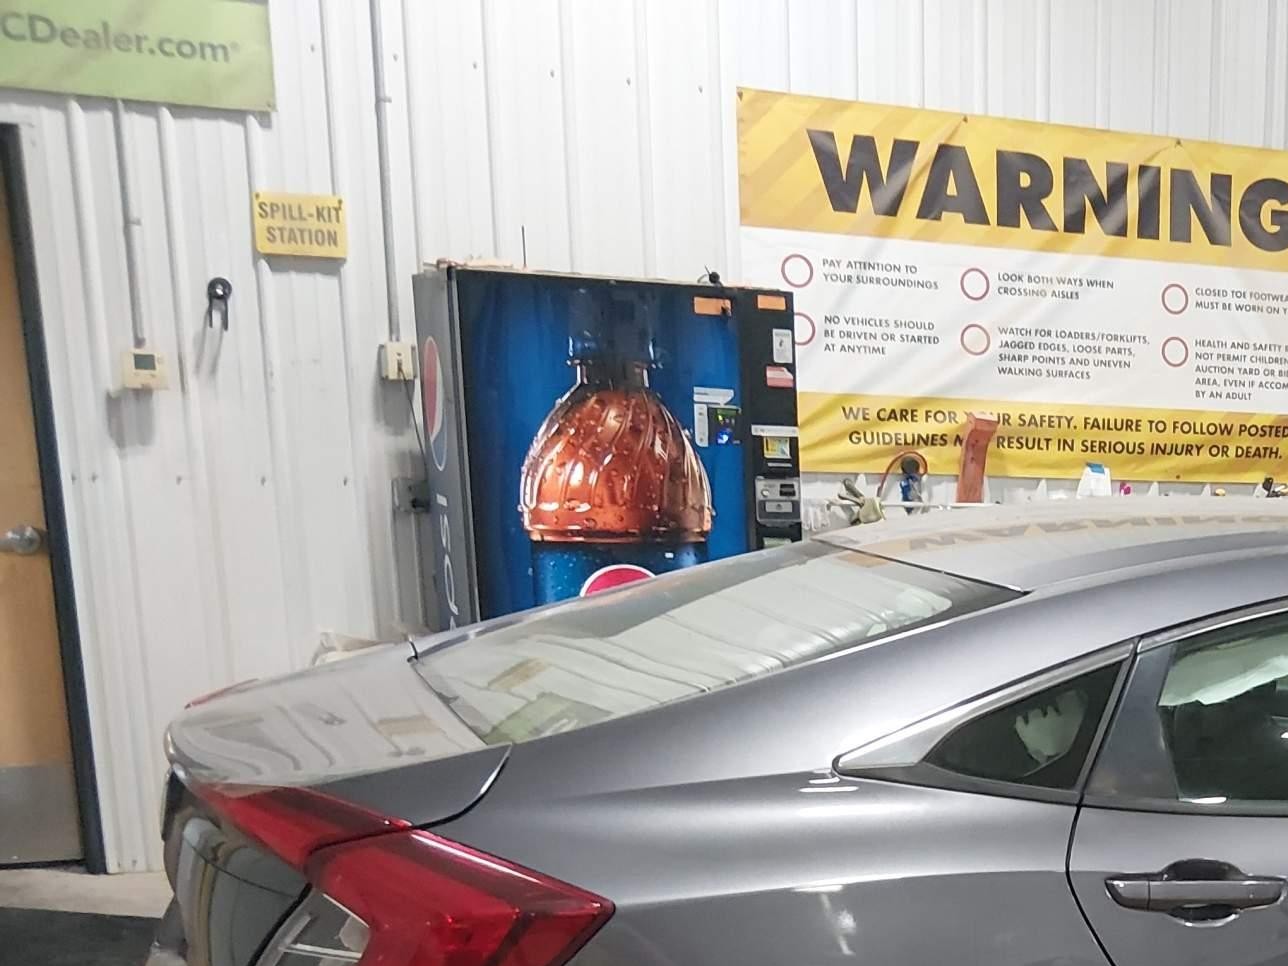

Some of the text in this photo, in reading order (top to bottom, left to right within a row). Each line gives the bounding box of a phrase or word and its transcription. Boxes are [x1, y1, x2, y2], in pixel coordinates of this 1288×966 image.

[258, 201, 342, 224] SPILL-KIT
[266, 226, 338, 247] STATION
[823, 258, 918, 274] PAY ATTENTION TO
[823, 273, 939, 290] YOUR SURROUNDINGS
[998, 272, 1114, 289] LOOK BOTH WAYS WHEN
[998, 286, 1079, 300] CROSSING AISLES
[1195, 288, 1228, 298] CLOSED
[1231, 290, 1247, 299] TOE
[1195, 301, 1219, 310] MUST
[1222, 303, 1232, 311] BE
[1235, 304, 1263, 313] WORN
[1266, 306, 1280, 315] ON
[824, 315, 935, 331] NO VEHICLES SHOULD
[824, 330, 940, 345] BE DRIVEN OR STARTED
[998, 327, 1150, 345] WATCH FOR LOADERS/FORKLIFTS,
[824, 344, 886, 355] AT ANYTIME
[998, 340, 1035, 350] JAGGED
[1073, 345, 1101, 354] LOOSE
[1195, 339, 1227, 349] HEALTH
[1230, 341, 1250, 350] AND
[1253, 343, 1282, 353] SAFETY
[998, 354, 1131, 368] SHARP POINTS AND UNEVEN
[1195, 352, 1213, 361] NOT
[1217, 353, 1247, 363] PERMIT
[998, 366, 1091, 379] WALKING SURFACES
[1195, 365, 1235, 374] AUCTION
[1238, 367, 1260, 376] YARD
[1263, 369, 1275, 377] OR
[1195, 378, 1220, 387] AREA,
[1224, 379, 1245, 388] EVEN
[1248, 381, 1255, 389] IF
[1195, 390, 1252, 401] BY AN ADULT
[841, 406, 870, 421] WE
[876, 407, 918, 423] CARE
[924, 409, 959, 424] FOR
[1018, 414, 1078, 430] SAFETY.
[1083, 417, 1142, 433] FAILURE
[1148, 420, 1167, 434] TO
[1172, 421, 1233, 437] FOLLOW
[849, 430, 947, 447] GUIDELINES
[996, 435, 1052, 451] RESULT
[1057, 438, 1075, 452] IN
[1080, 440, 1145, 455] SERIOUS
[1151, 443, 1204, 457] INJURY
[1208, 444, 1229, 458] OR
[1235, 446, 1283, 460] DEATH.
